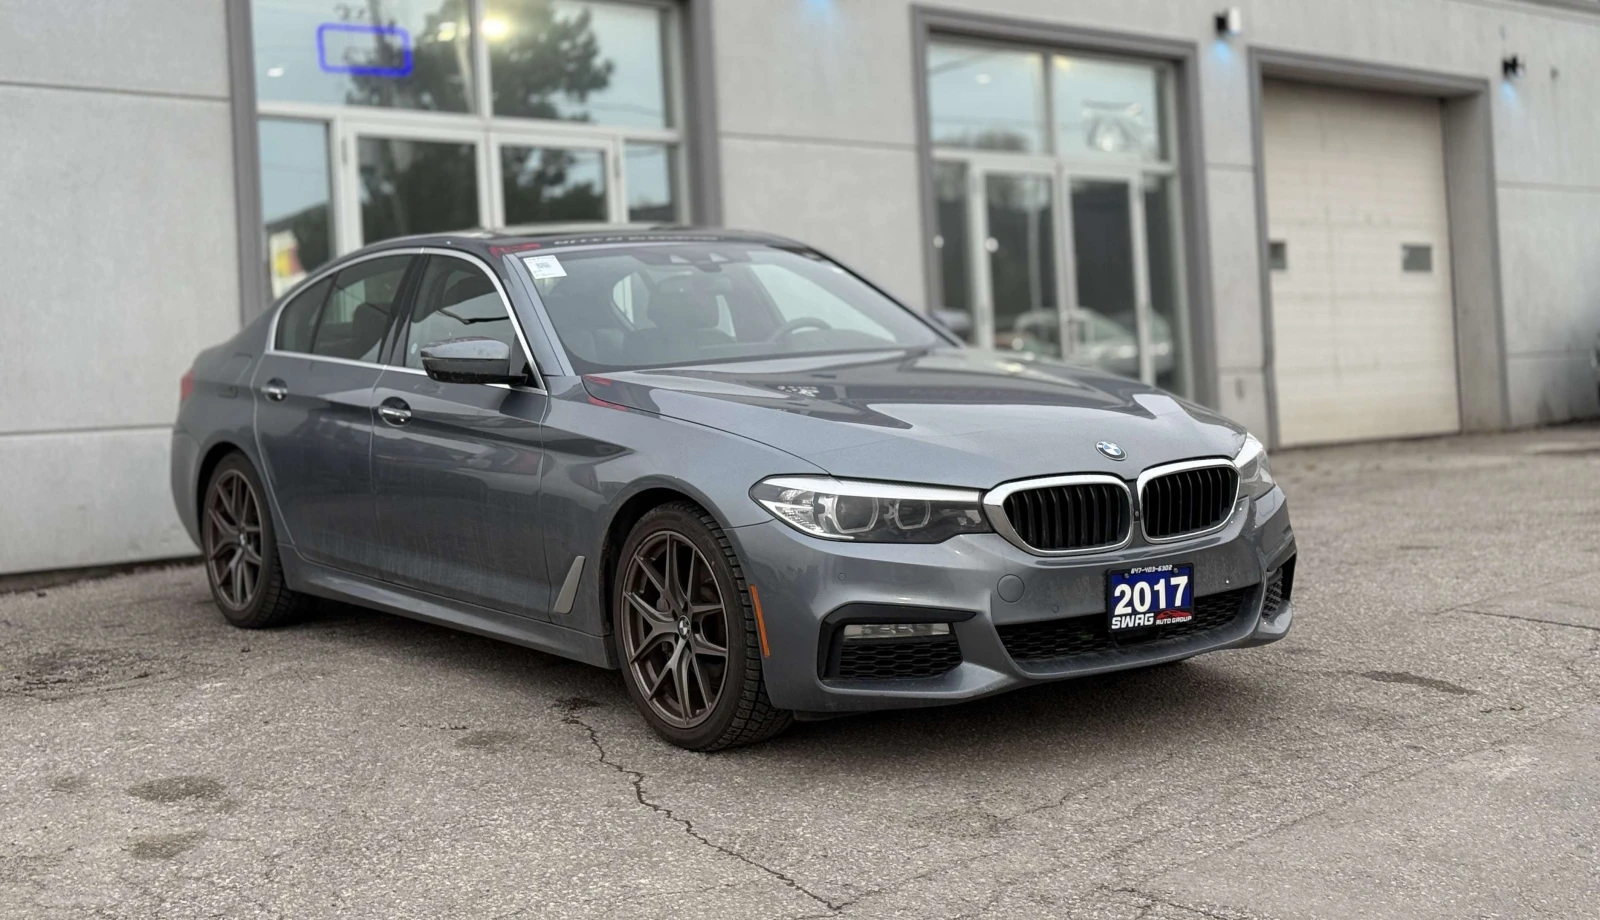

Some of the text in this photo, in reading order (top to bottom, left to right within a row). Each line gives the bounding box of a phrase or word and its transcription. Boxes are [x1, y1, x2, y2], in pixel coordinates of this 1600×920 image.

[1114, 576, 1188, 615] 2017
[1111, 613, 1155, 629] SWAG
[1171, 615, 1192, 624] GROUP
